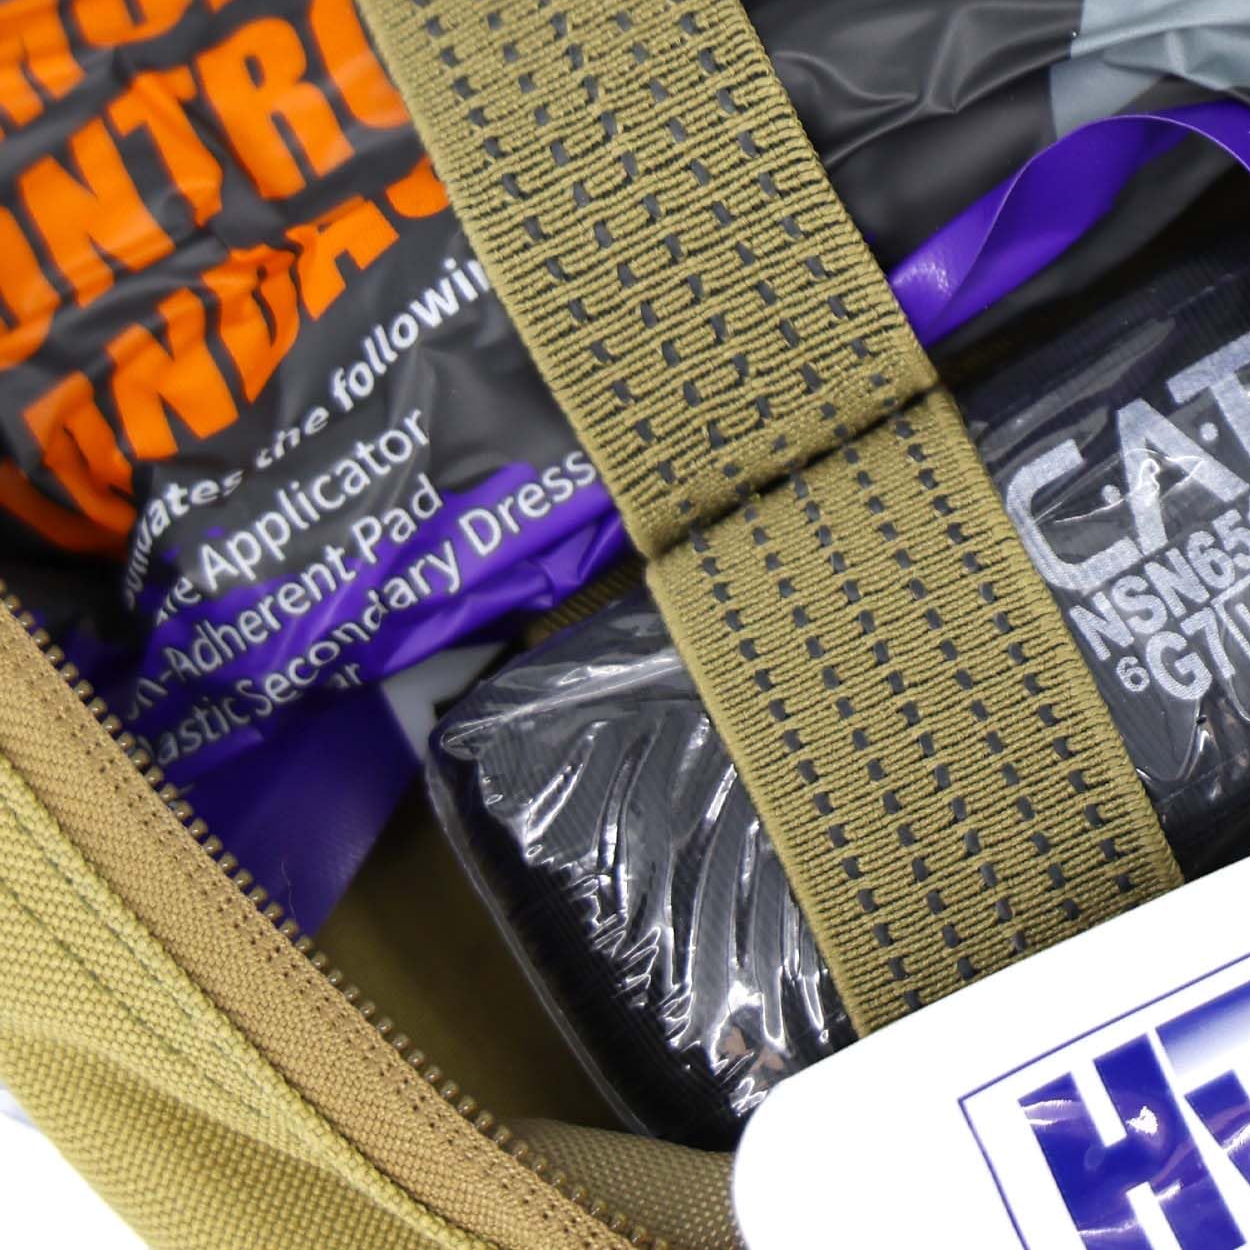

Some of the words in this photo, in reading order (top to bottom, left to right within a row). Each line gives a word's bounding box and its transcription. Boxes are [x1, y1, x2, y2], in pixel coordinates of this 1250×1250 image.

[201, 408, 431, 591] Applicator
[237, 542, 461, 716] Secondary
[459, 450, 597, 556] Dress
[352, 473, 443, 564] Pad
